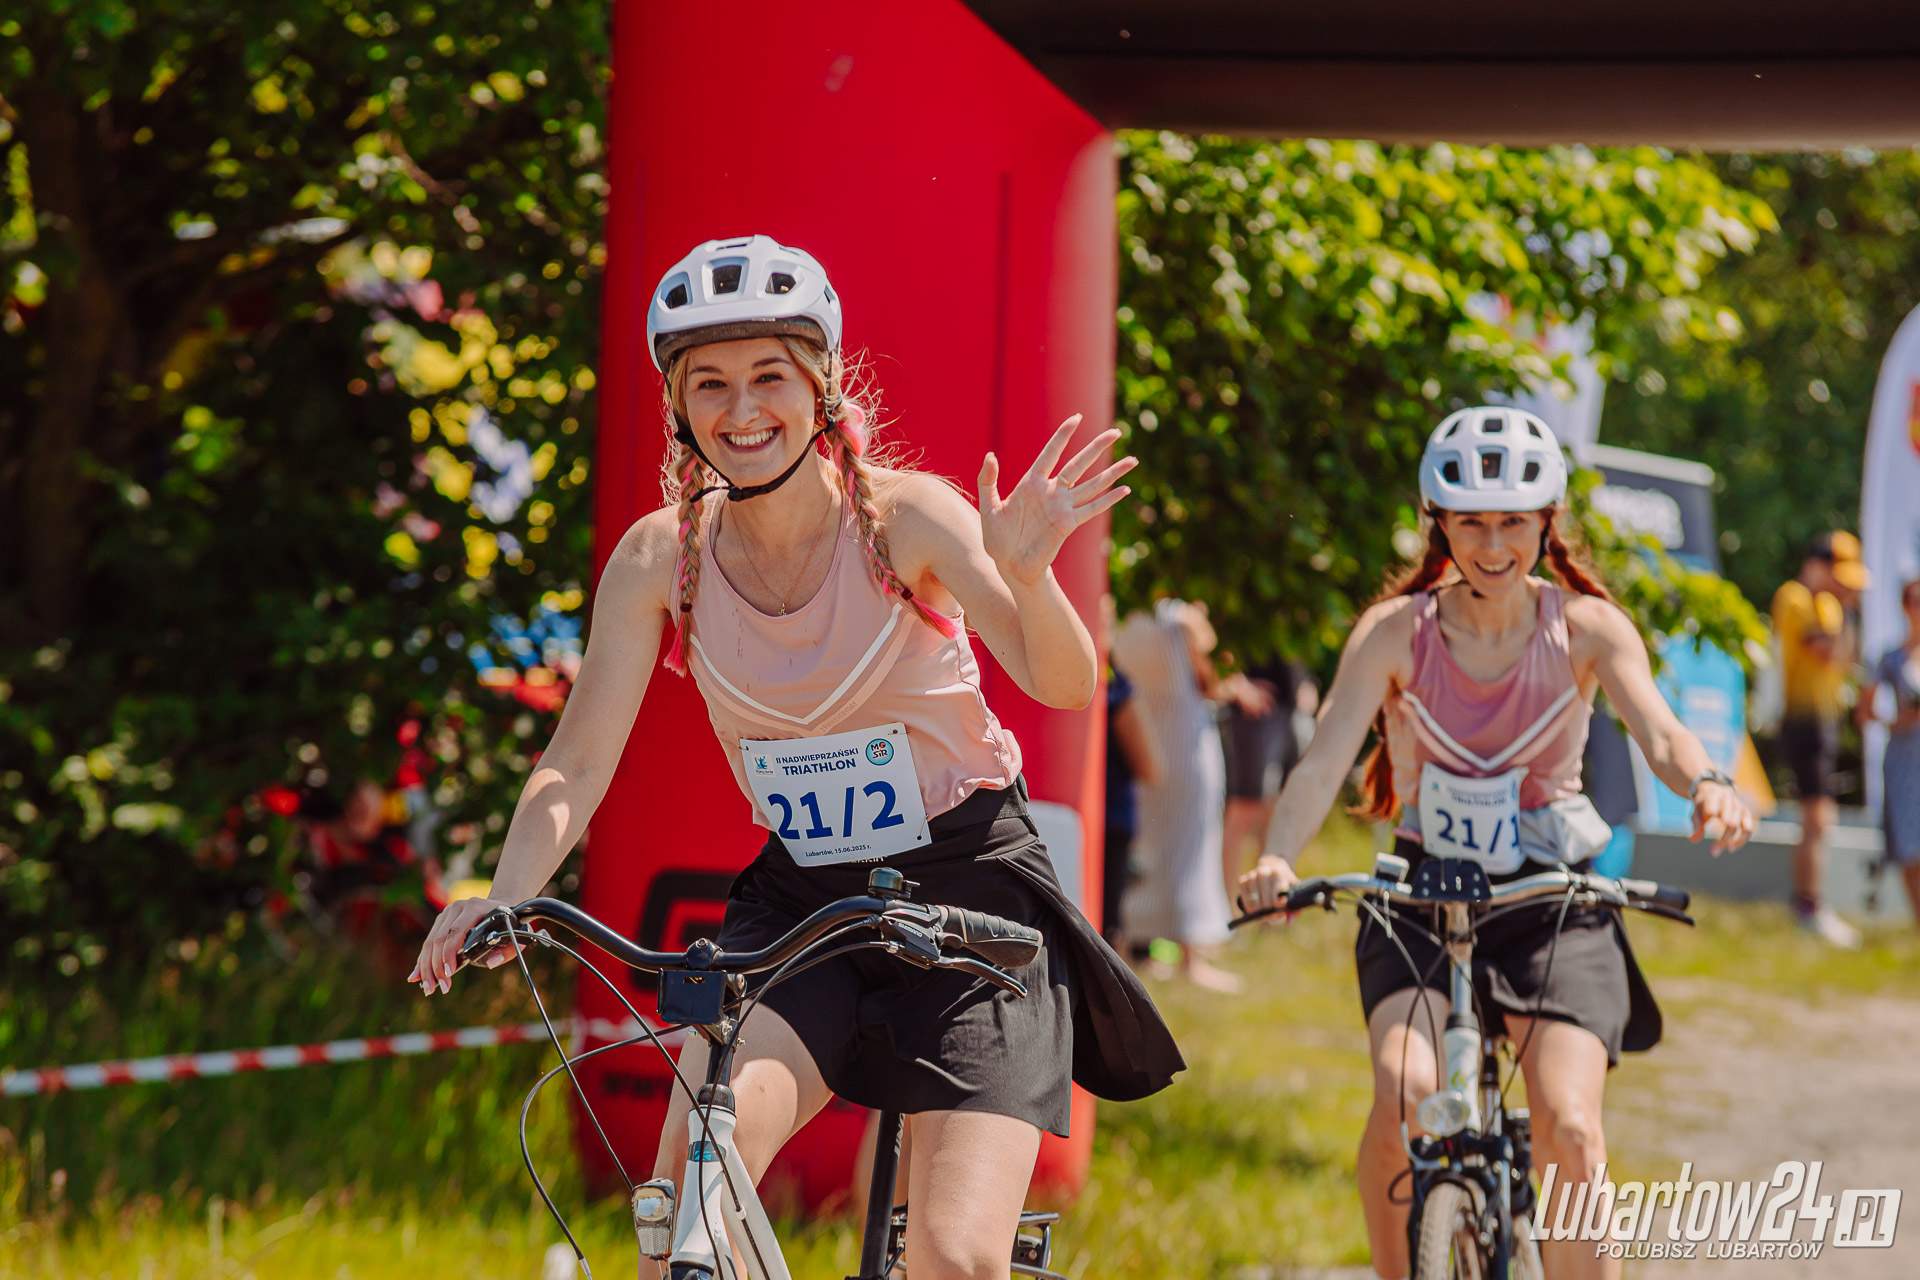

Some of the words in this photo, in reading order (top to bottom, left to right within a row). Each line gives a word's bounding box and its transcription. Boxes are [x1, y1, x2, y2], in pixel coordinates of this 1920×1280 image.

[781, 747, 859, 764] NADWIEPRZAŃSKI
[782, 758, 857, 776] TRIATHLON
[767, 780, 905, 840] 21/2
